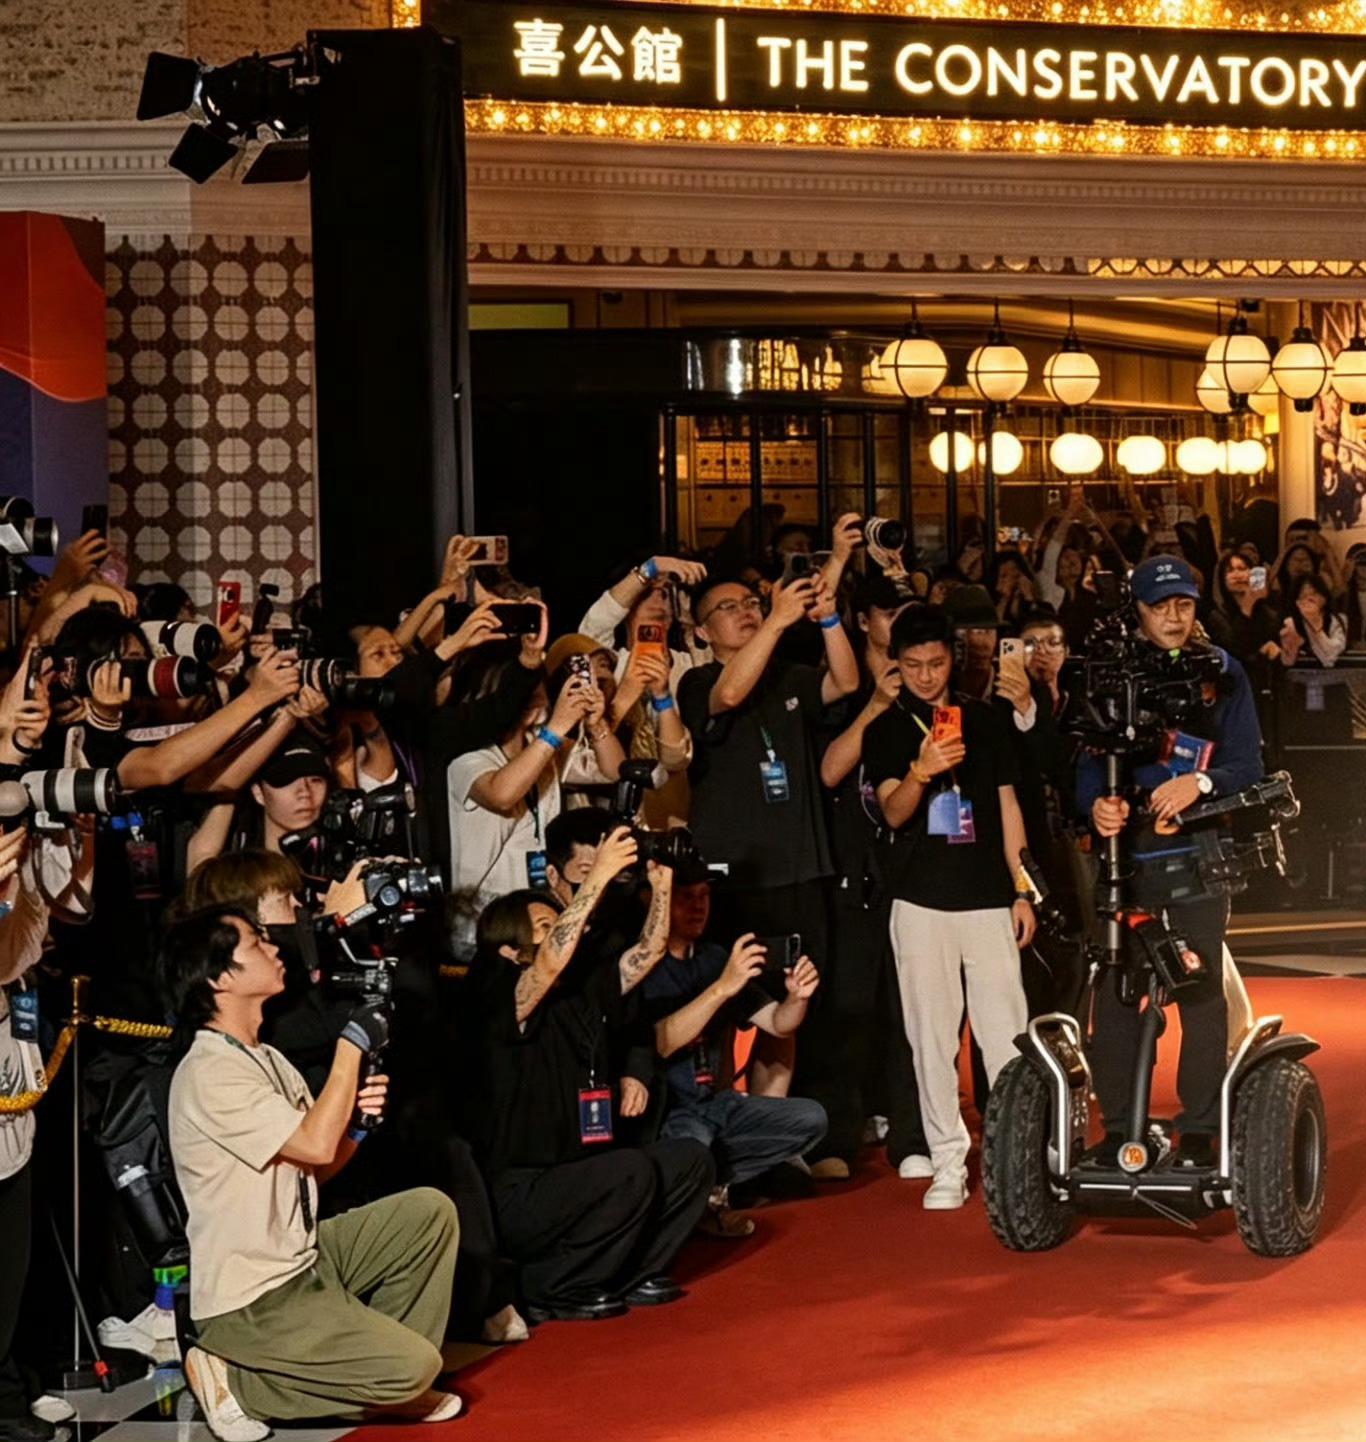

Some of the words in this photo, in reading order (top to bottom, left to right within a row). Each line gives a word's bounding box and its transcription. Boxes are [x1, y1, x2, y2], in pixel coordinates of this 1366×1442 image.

[513, 18, 683, 84] 喜公館
[757, 36, 869, 91] THE
